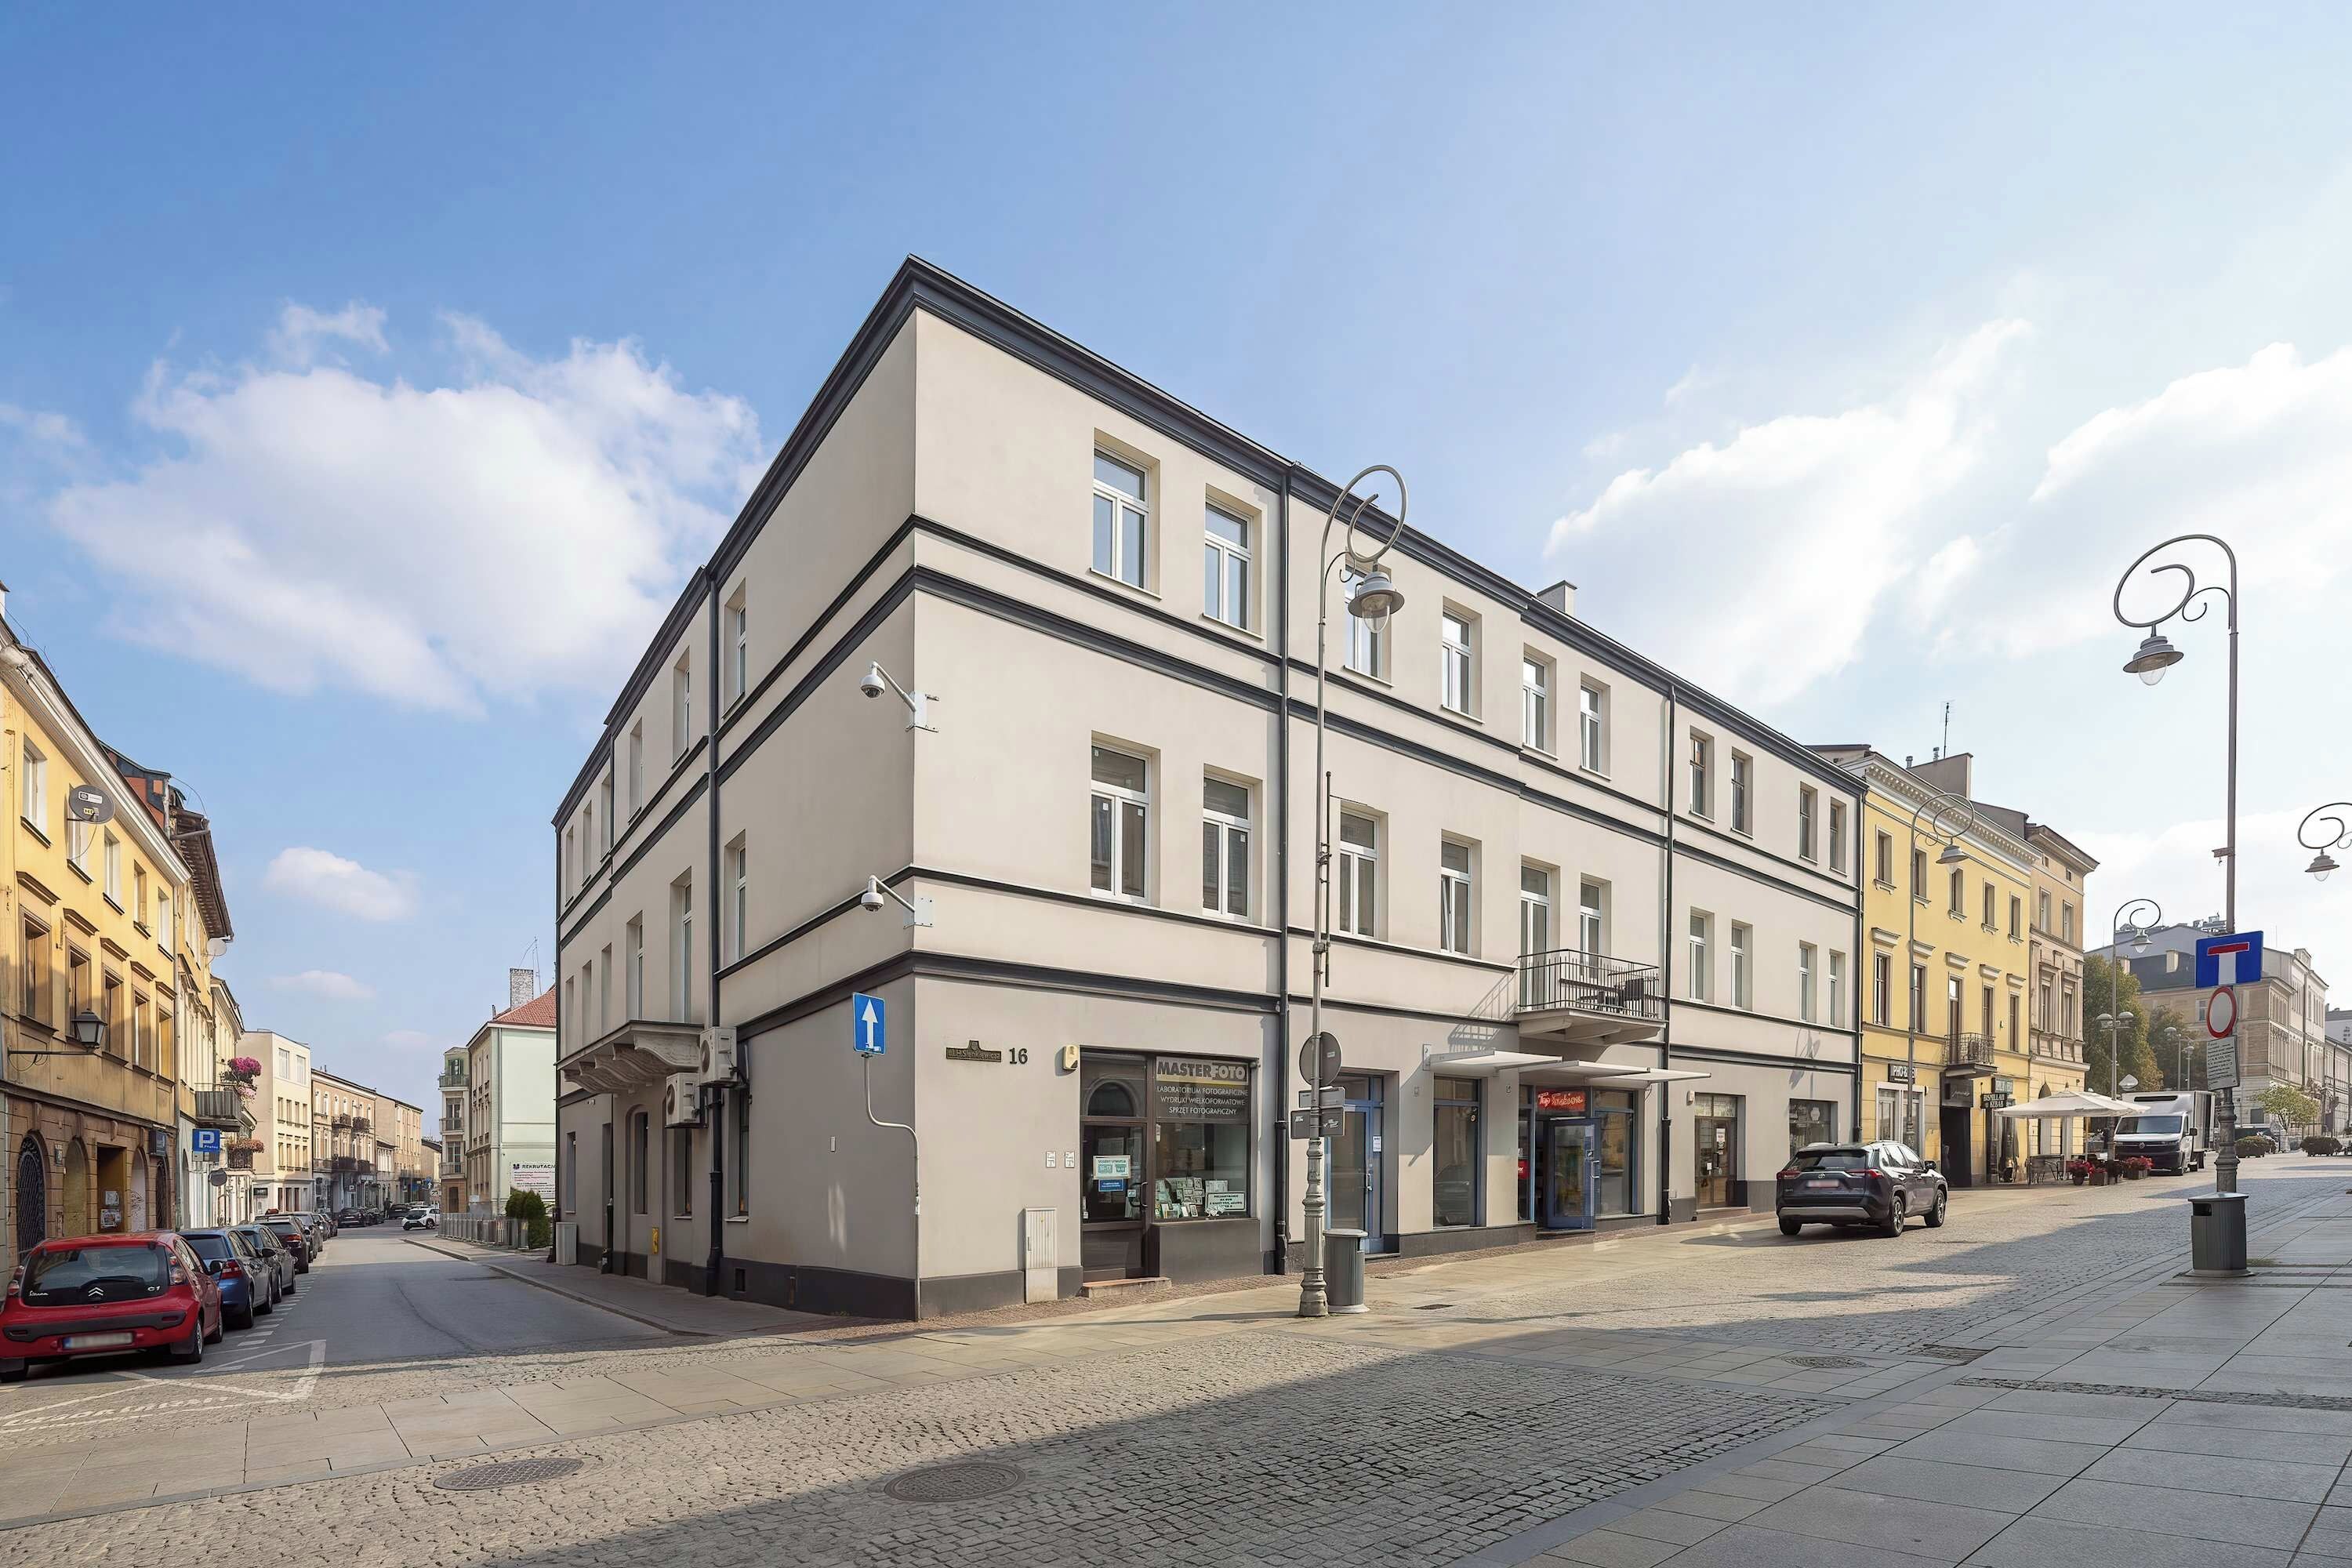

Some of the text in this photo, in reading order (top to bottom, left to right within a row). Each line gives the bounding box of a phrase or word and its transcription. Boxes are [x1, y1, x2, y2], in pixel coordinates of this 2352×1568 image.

[1009, 1047, 1028, 1064] 16
[1157, 1086, 1248, 1096] LABORATORIUM FOTOGRAFICZNE
[199, 1131, 215, 1148] P
